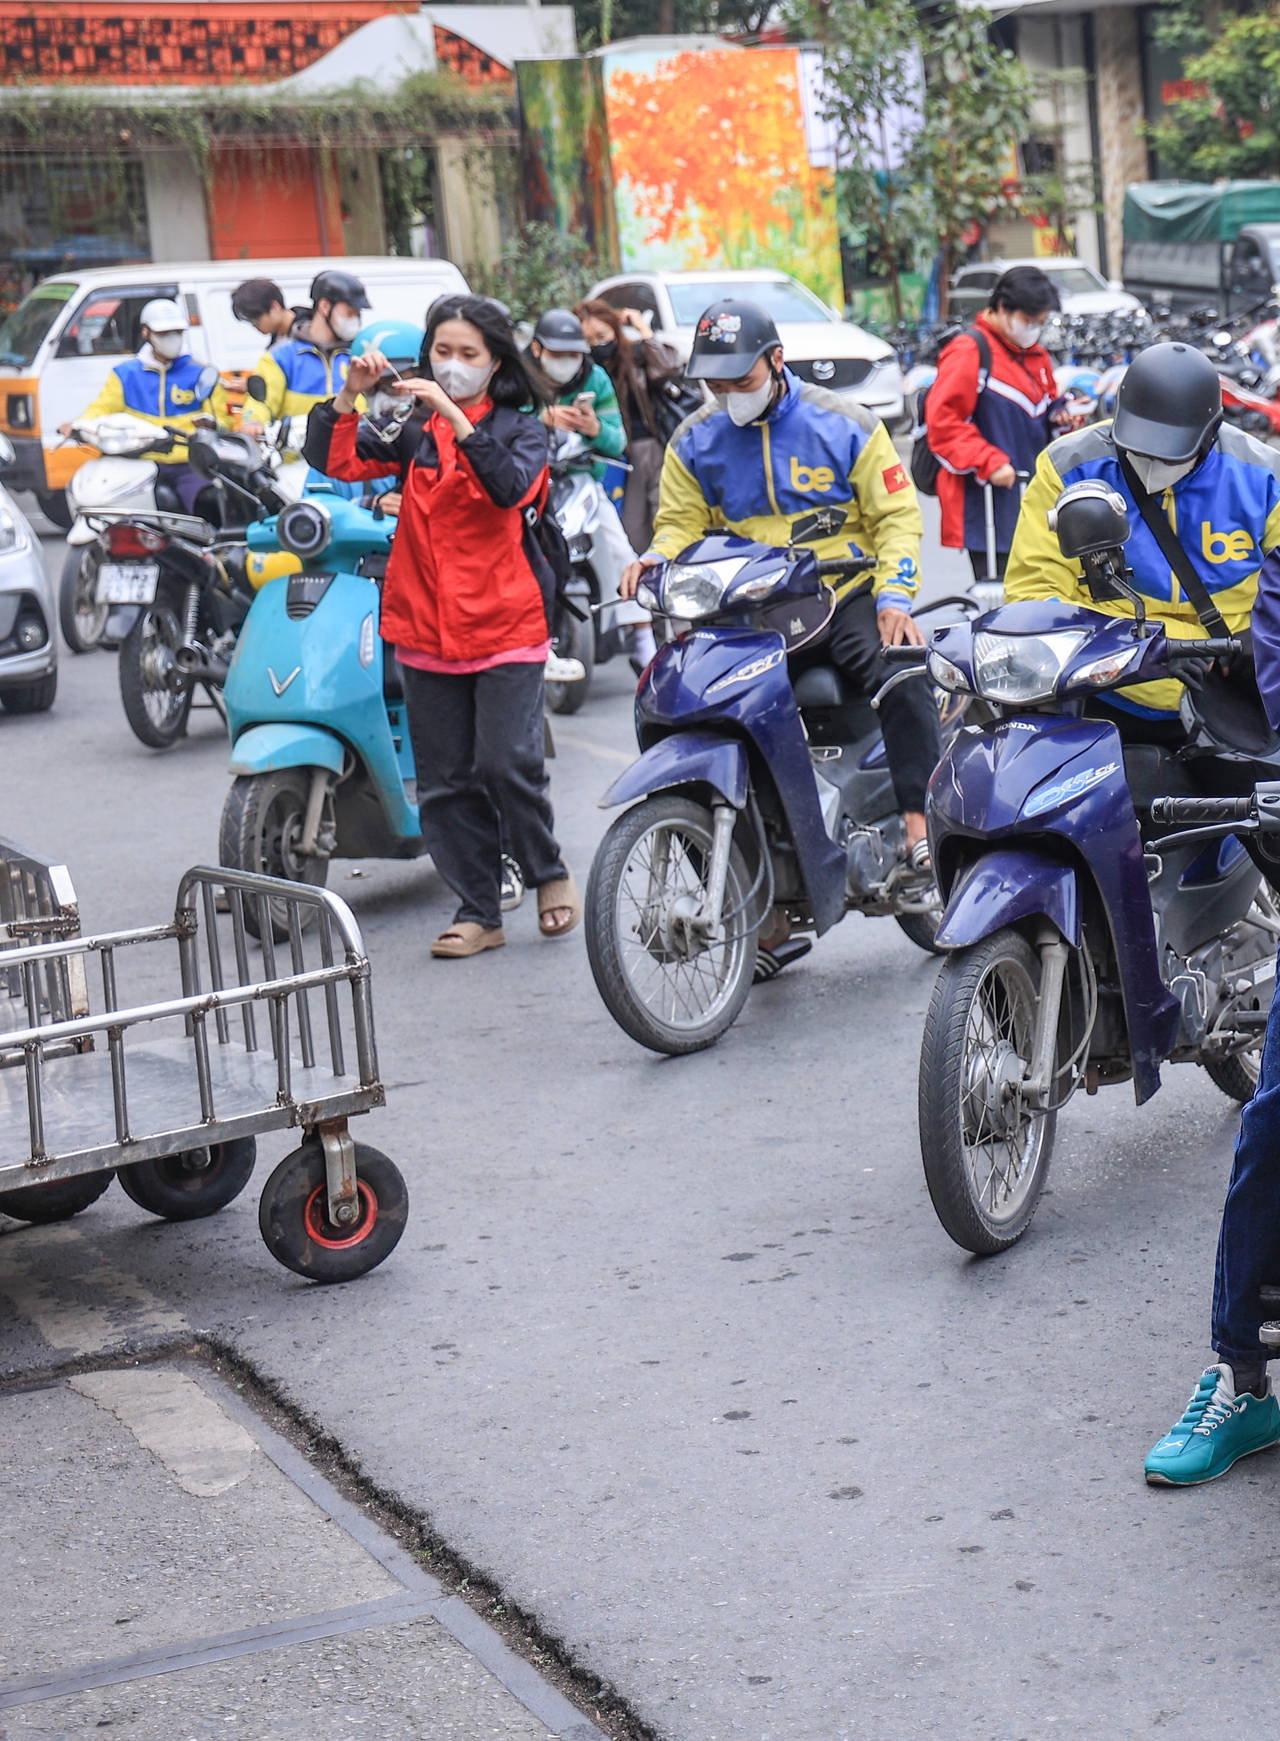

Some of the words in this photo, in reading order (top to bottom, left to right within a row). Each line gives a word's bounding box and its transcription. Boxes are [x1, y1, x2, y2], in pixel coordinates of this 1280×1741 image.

[790, 456, 836, 493] be
[1201, 521, 1254, 565] be
[994, 721, 1039, 733] HONDA
